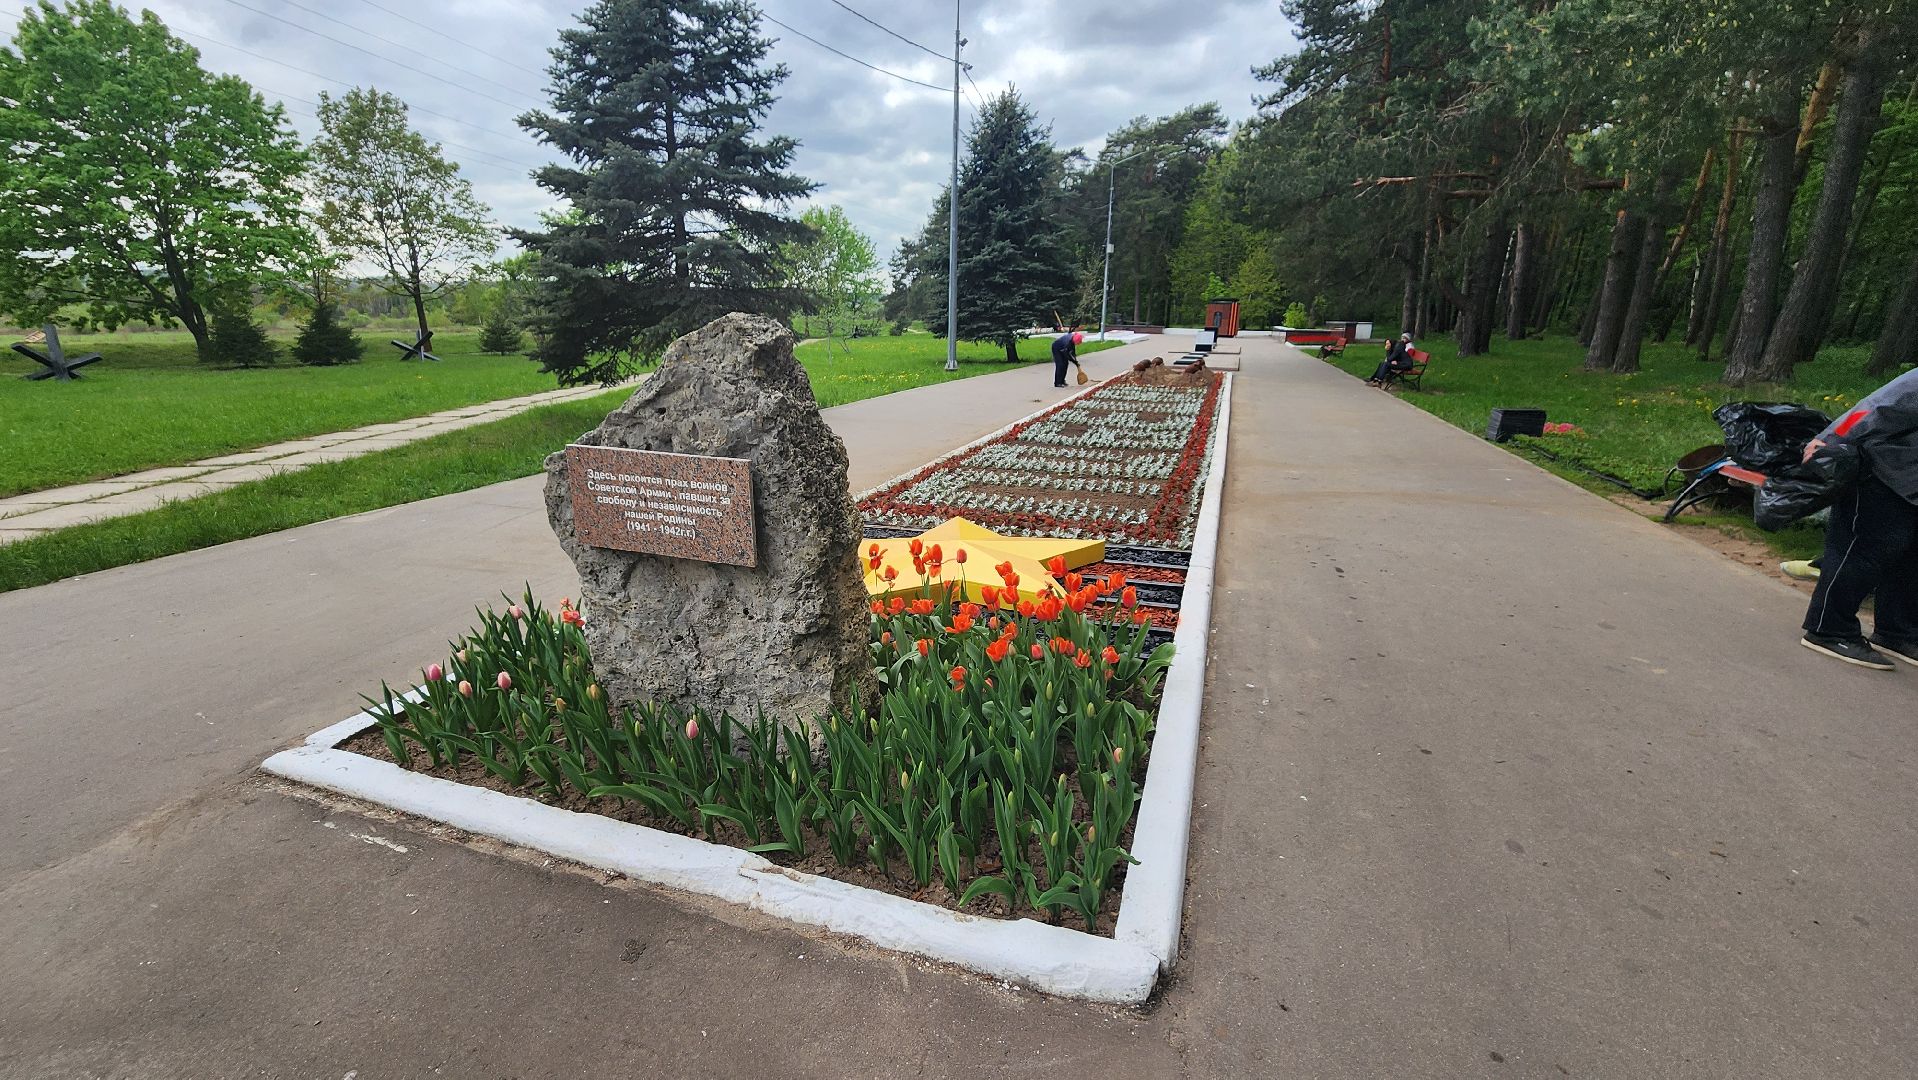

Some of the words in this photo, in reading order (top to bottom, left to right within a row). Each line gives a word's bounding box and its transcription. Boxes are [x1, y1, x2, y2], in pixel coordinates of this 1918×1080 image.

[587, 469, 616, 480] Здесь
[618, 474, 663, 485] покоится
[665, 478, 689, 488] прах
[690, 481, 728, 492] воинов
[587, 481, 637, 494] Советской
[640, 486, 672, 498] Армии
[679, 492, 717, 503] павших
[720, 496, 731, 505] за
[597, 495, 637, 508] свободу
[648, 501, 723, 517] независимость
[624, 510, 655, 520] нашей
[657, 512, 696, 526] Родины
[627, 520, 651, 531] (1941
